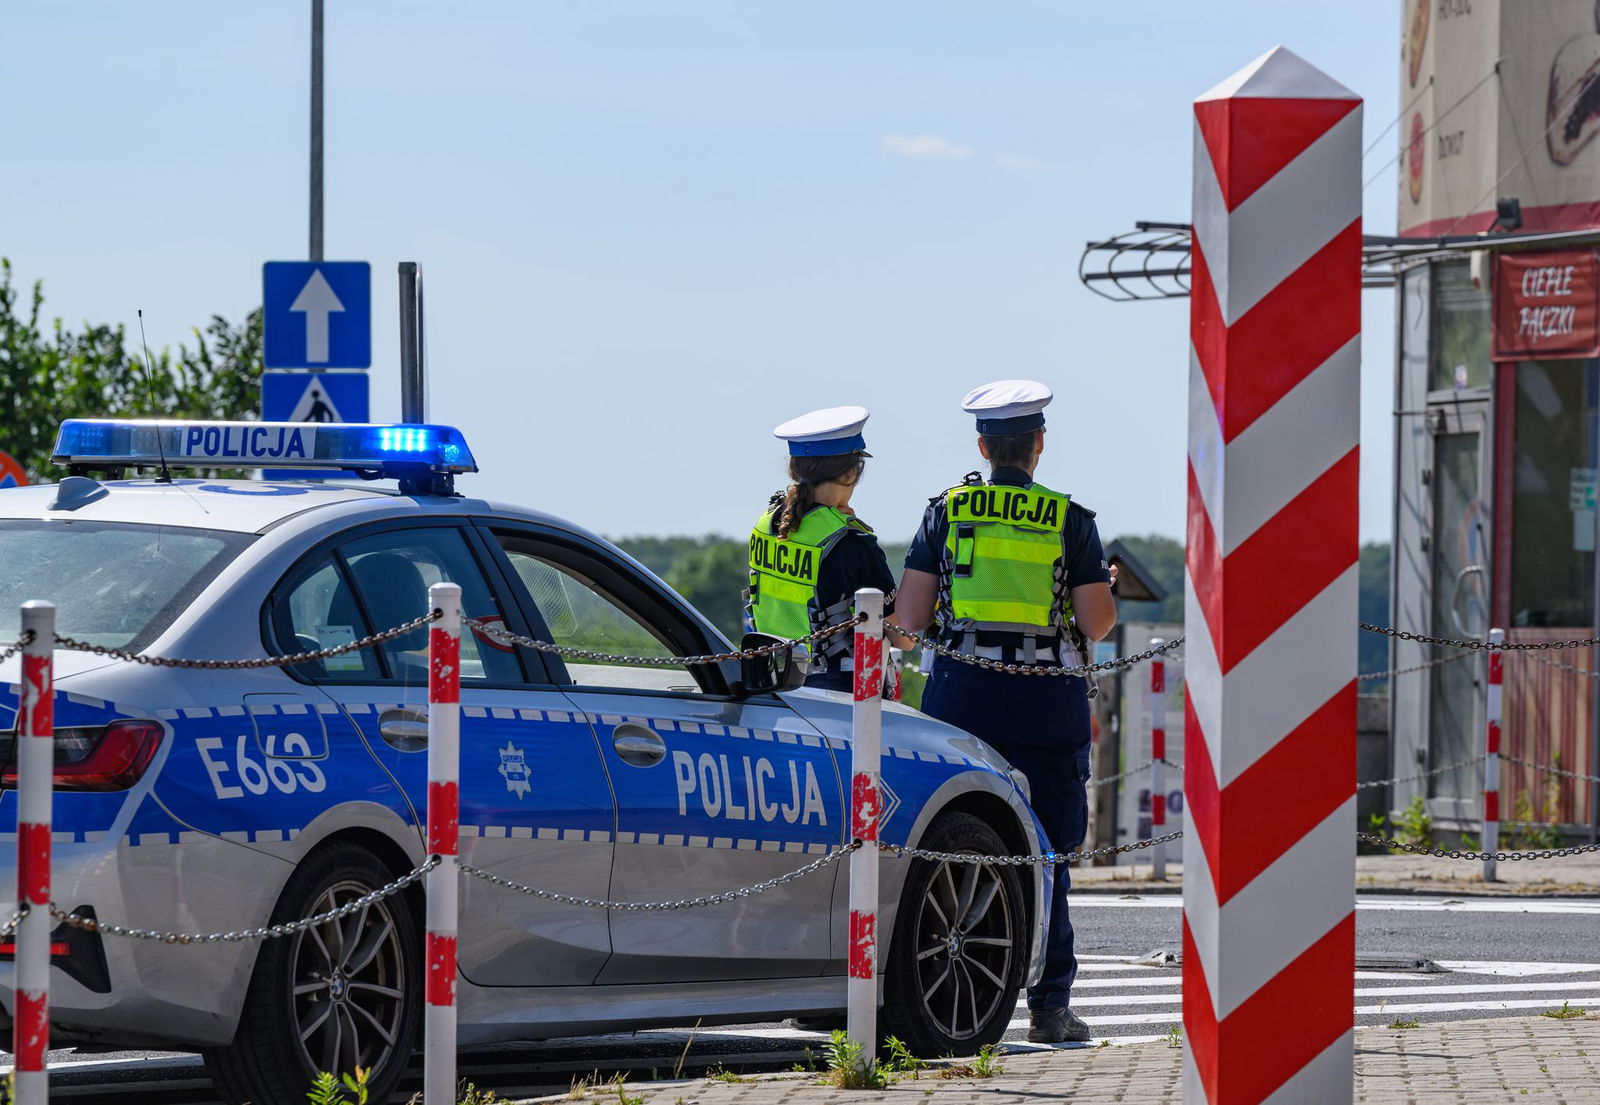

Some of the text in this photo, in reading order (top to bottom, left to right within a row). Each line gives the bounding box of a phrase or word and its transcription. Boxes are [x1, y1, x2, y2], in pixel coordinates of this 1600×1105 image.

[186, 426, 305, 458] POLICJA
[952, 490, 1058, 527] POLICJA
[749, 533, 813, 580] POLICJA
[195, 733, 326, 800] E663
[672, 750, 828, 826] POLICJA
